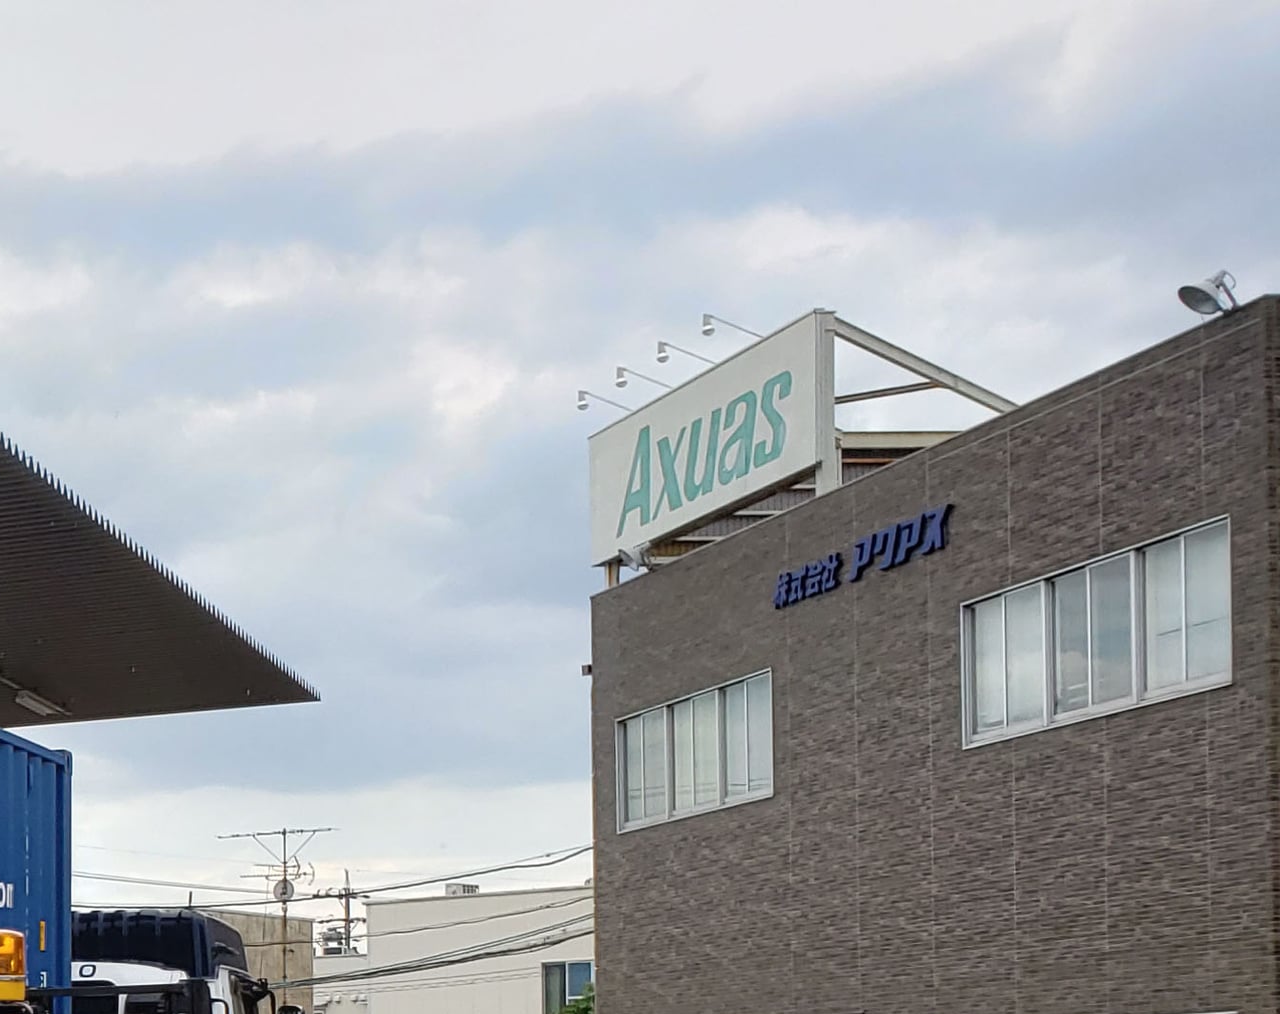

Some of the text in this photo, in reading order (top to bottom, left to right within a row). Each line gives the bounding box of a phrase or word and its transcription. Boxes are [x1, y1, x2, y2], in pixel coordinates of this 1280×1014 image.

[616, 370, 793, 539] Axuas
[773, 503, 955, 610] 株式会社 アクアス
